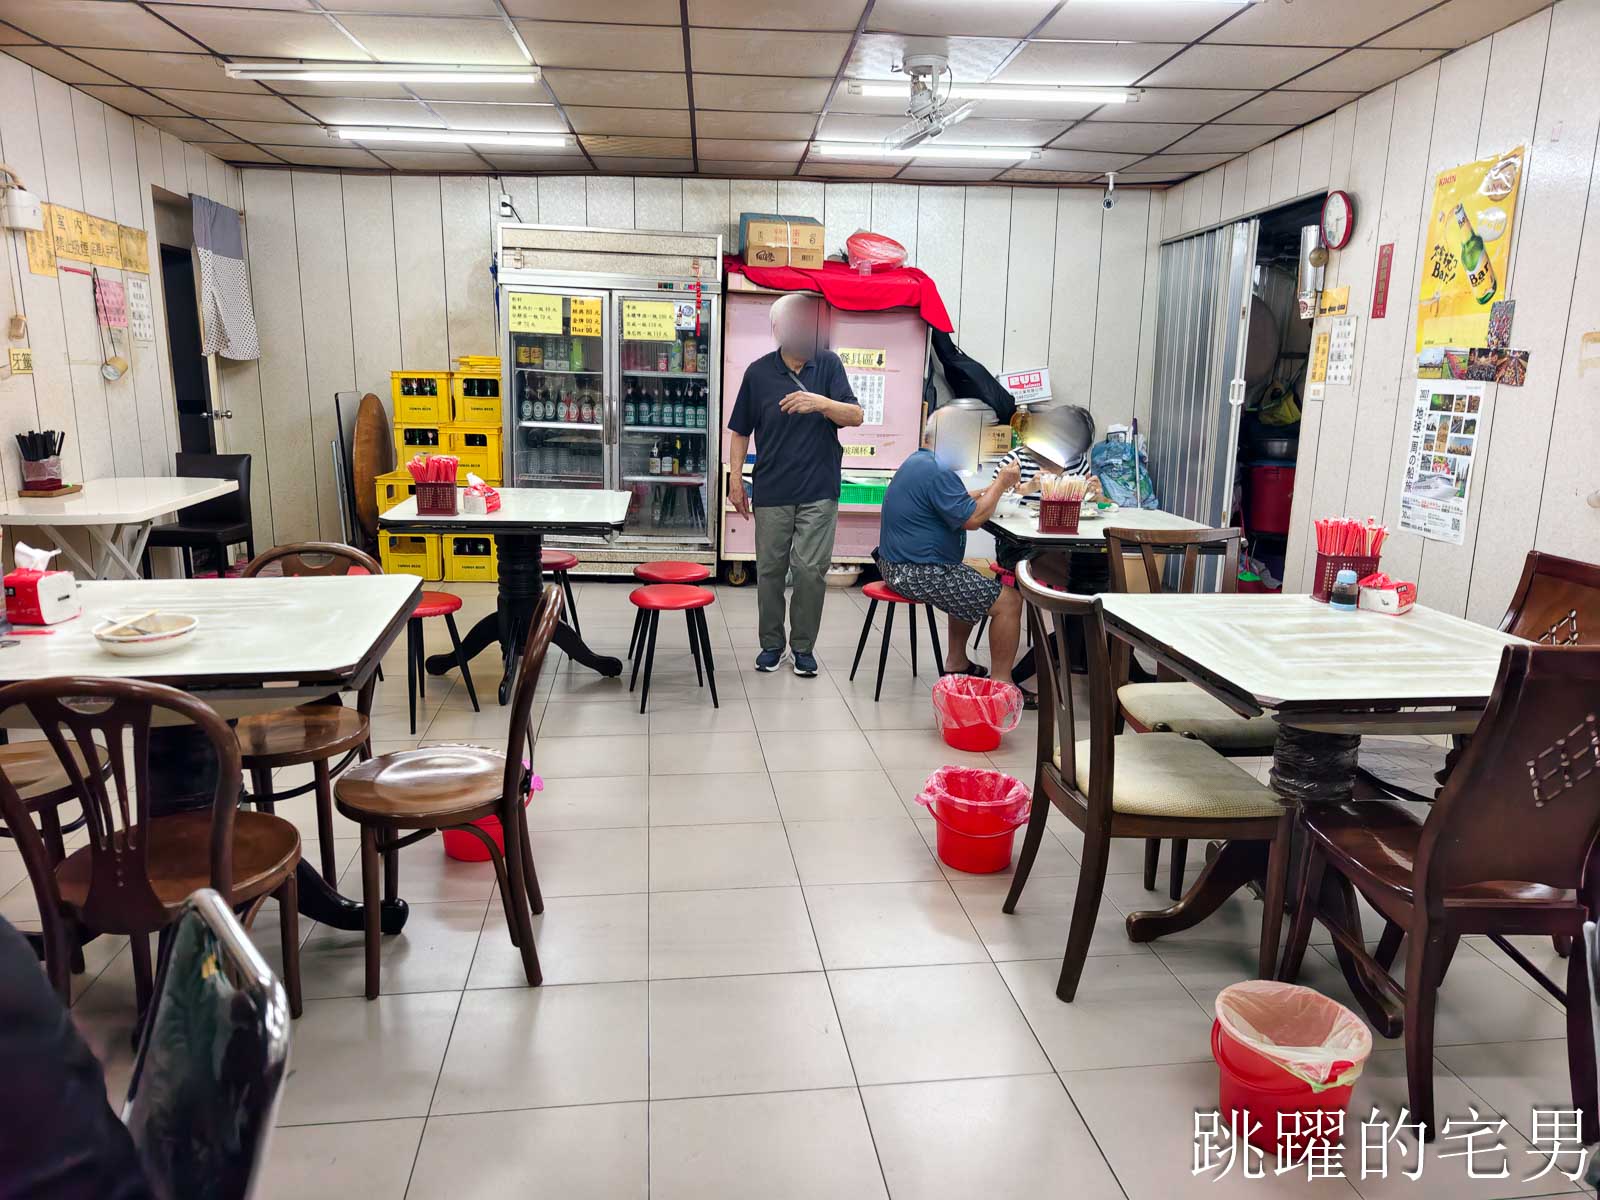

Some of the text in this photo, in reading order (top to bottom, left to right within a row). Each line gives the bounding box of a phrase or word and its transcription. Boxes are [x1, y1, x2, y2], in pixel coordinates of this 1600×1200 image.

[1469, 260, 1489, 284] Bar
[840, 352, 874, 365] 餐具區
[1403, 406, 1425, 494] 地球一周の船旅
